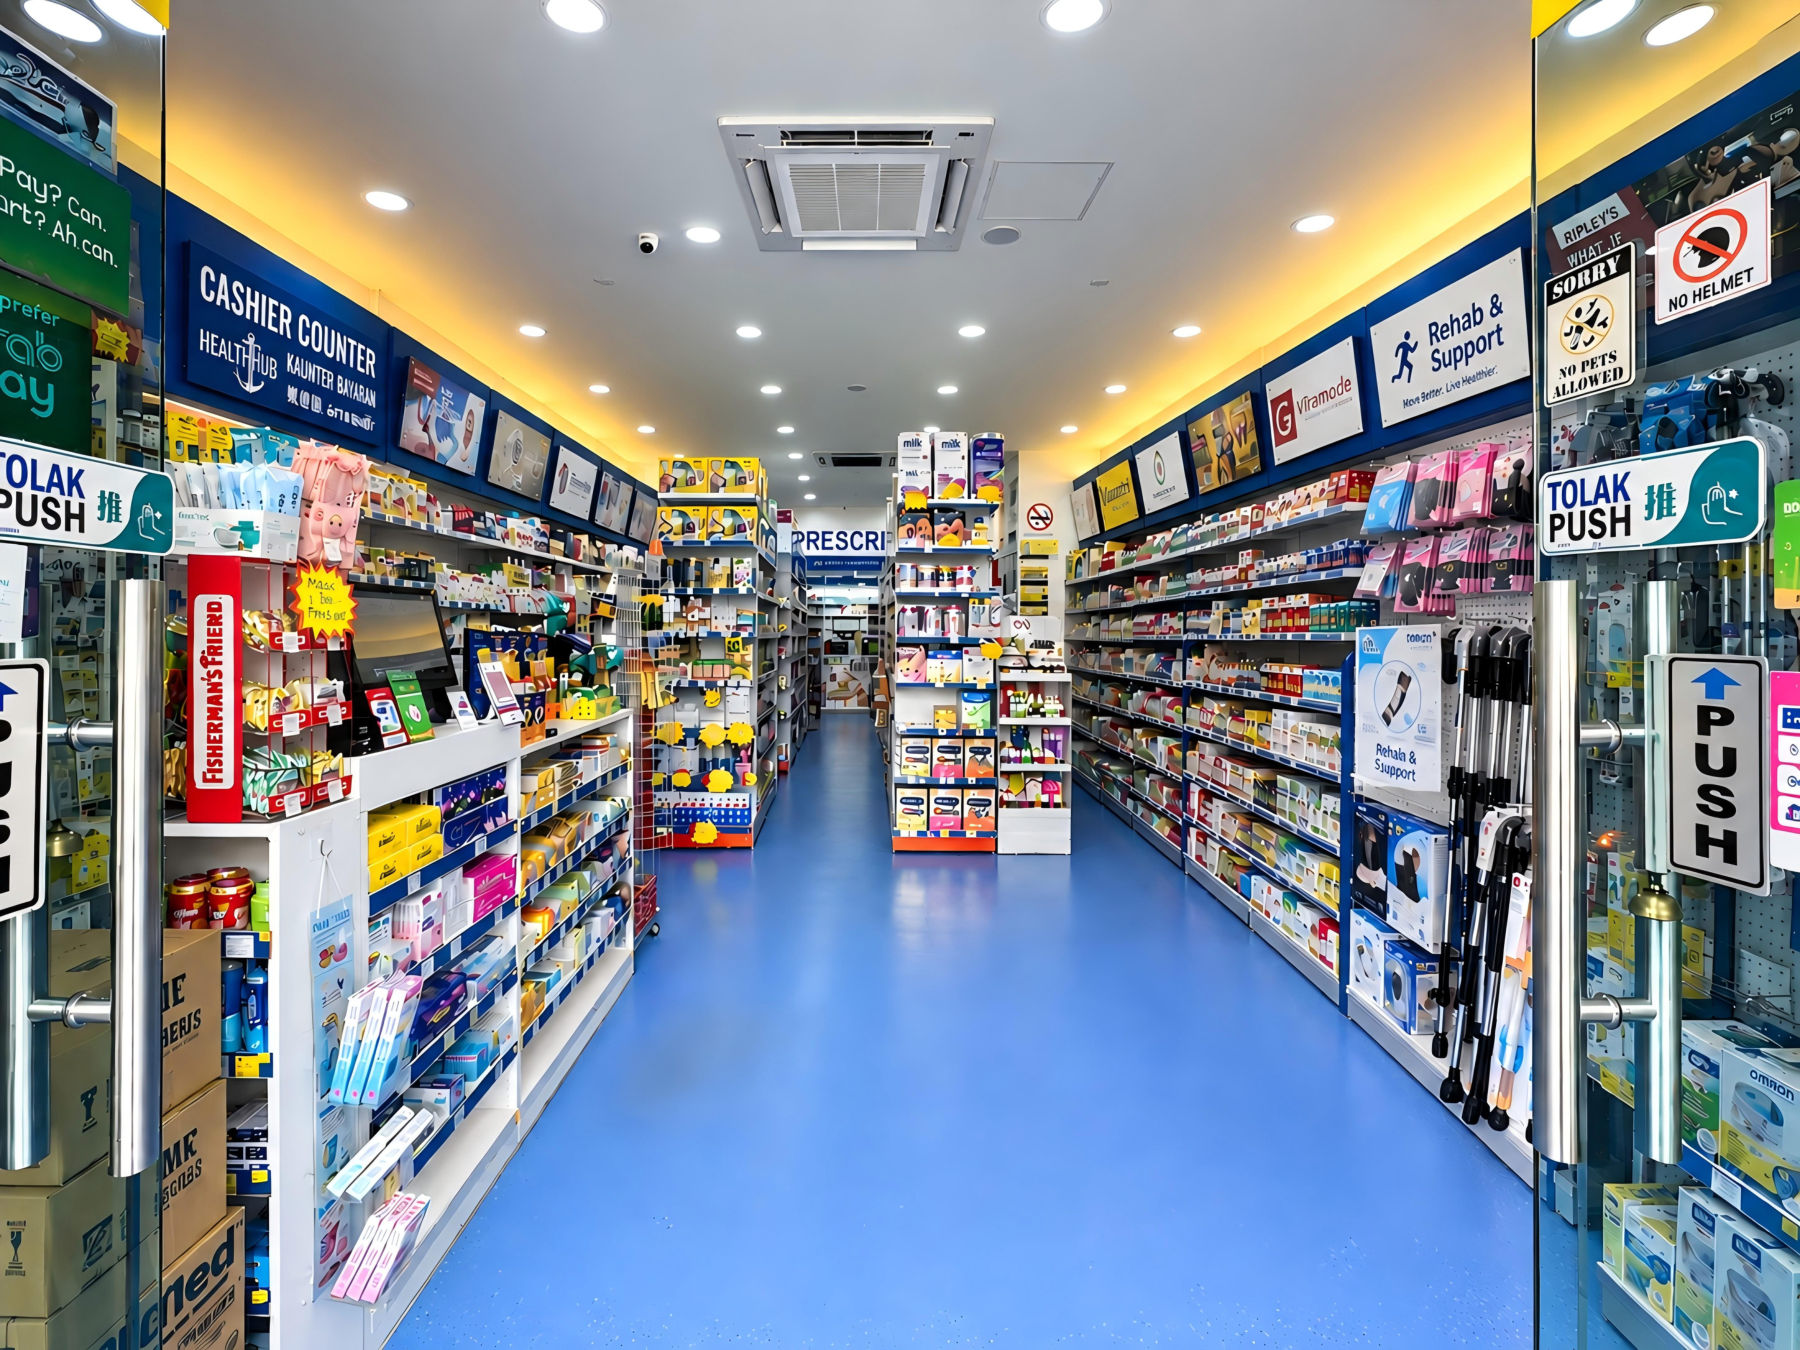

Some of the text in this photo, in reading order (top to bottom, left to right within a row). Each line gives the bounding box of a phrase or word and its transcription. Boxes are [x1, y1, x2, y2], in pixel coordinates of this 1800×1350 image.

[0, 155, 107, 232] Pay? Can.
[1563, 206, 1619, 245] RIPLEY'S
[1552, 254, 1621, 300] SORRY
[1668, 266, 1754, 312] NO HELMET
[0, 294, 60, 327] prefer
[200, 265, 376, 379] CASHIER COUNTER
[1428, 293, 1503, 346] Rehab &
[1431, 323, 1504, 372] Support
[1559, 349, 1617, 380] NO PETS
[286, 352, 334, 391] KAUNTER
[337, 374, 376, 408] BAYARAN
[1552, 366, 1624, 399] ALLOWED
[1547, 471, 1631, 511] TOLAK
[1549, 504, 1631, 543] PUSH
[201, 669, 223, 784] FISHERMAN'S
[1695, 704, 1738, 866] PUSH
